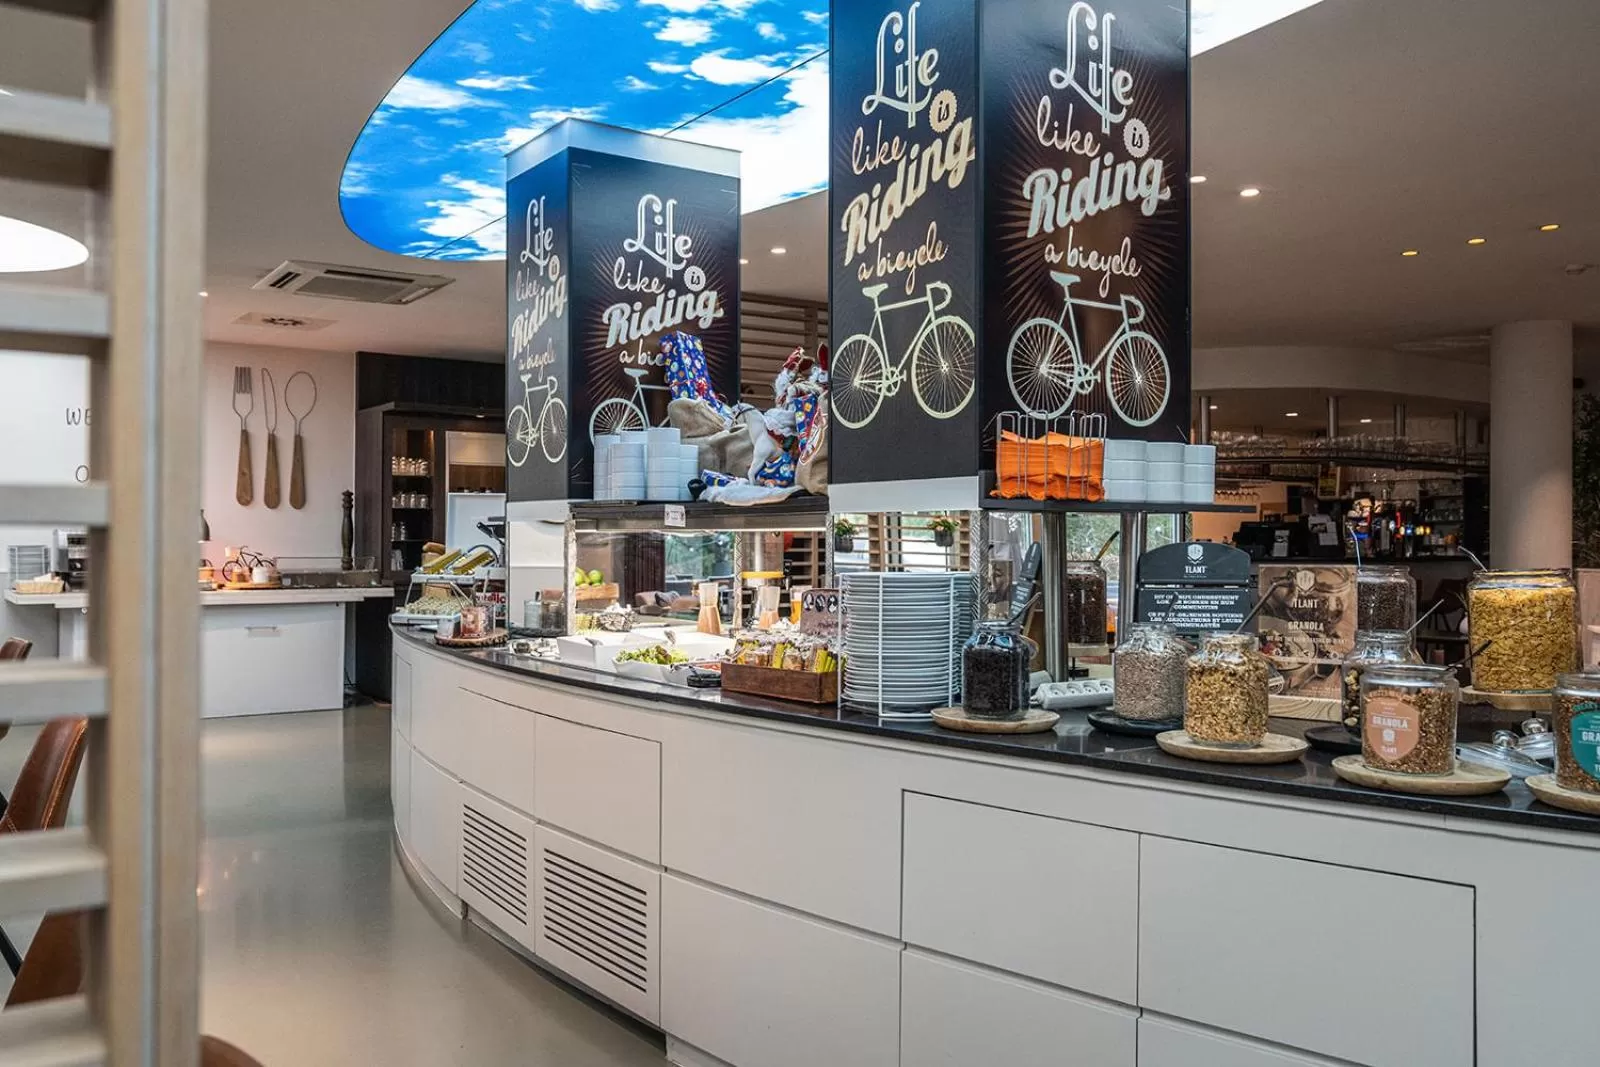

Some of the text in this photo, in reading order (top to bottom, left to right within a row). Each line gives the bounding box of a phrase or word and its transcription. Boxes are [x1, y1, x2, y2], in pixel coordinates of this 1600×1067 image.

[861, 1, 940, 130] Life
[1049, 1, 1134, 136] Life
[851, 119, 908, 176] like
[1036, 95, 1102, 158] like
[840, 116, 976, 267] Riding
[1022, 152, 1172, 239] Riding
[520, 195, 554, 277] Life
[623, 194, 693, 279] Life
[857, 220, 950, 295] a bicycle
[1044, 226, 1143, 299] a bicycle
[515, 267, 541, 302] like
[612, 256, 666, 294] like
[511, 274, 568, 360] Riding
[602, 289, 725, 349] Riding
[619, 350, 636, 364] a
[1582, 731, 1600, 743] GRA
